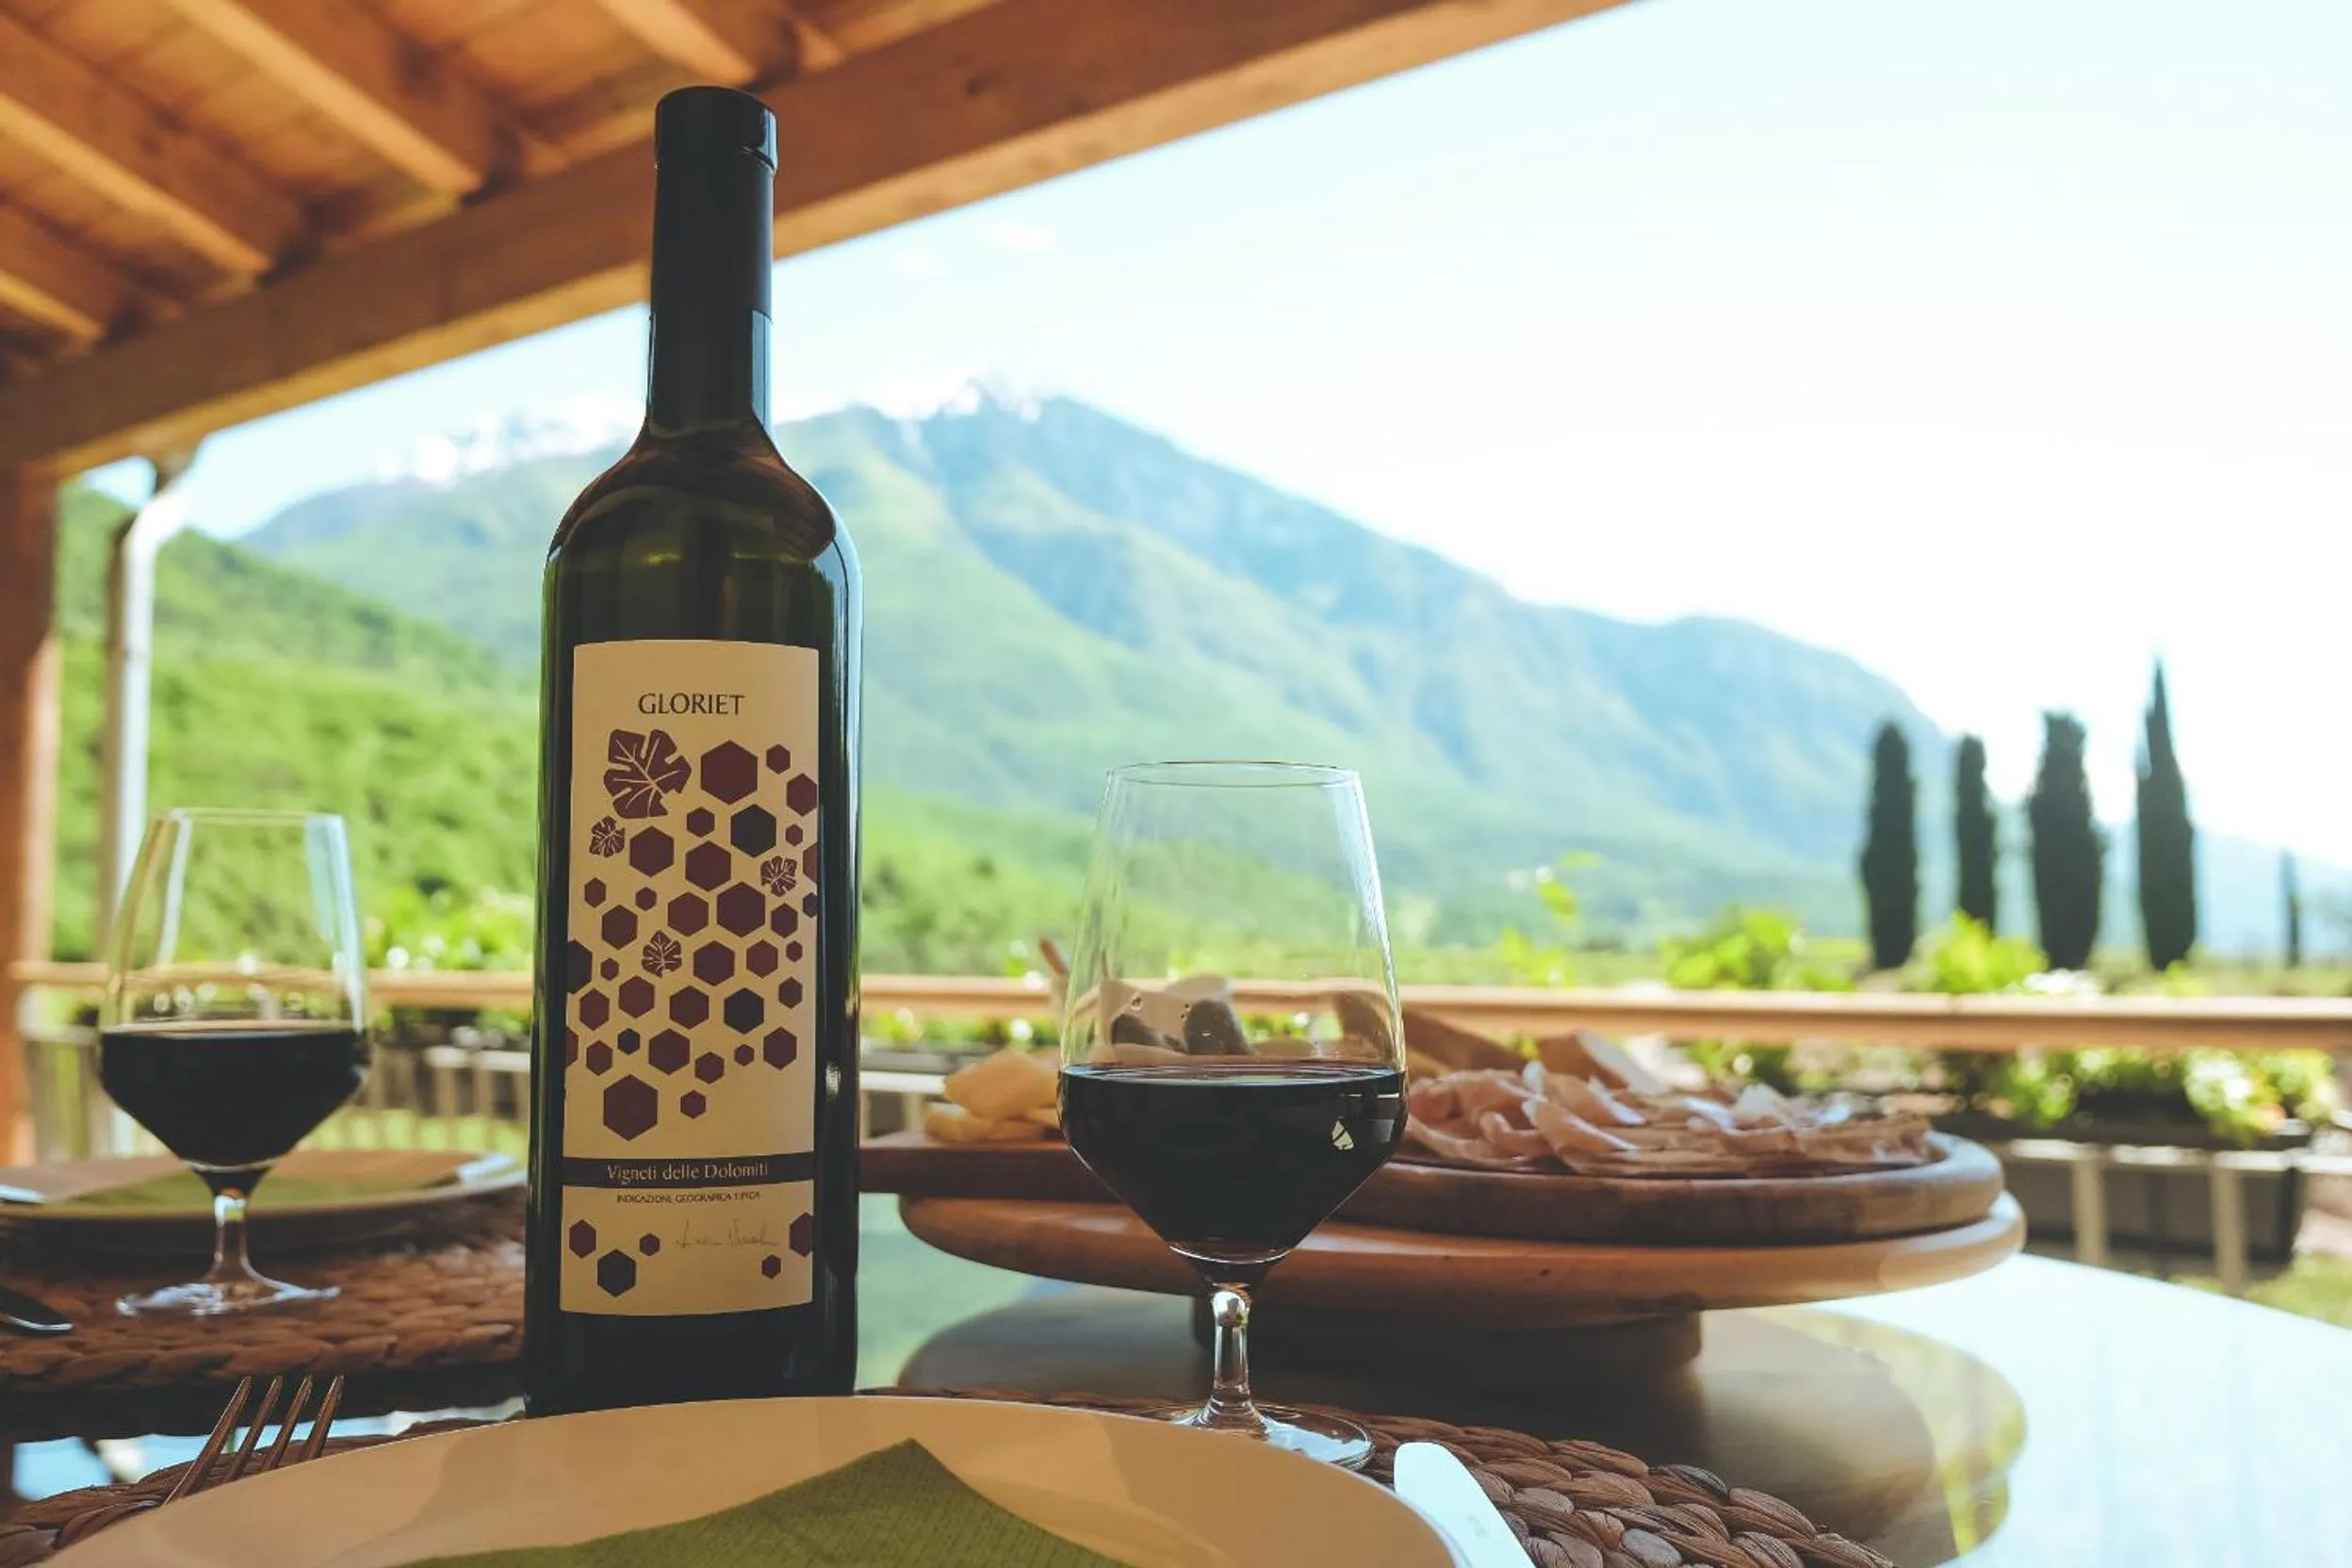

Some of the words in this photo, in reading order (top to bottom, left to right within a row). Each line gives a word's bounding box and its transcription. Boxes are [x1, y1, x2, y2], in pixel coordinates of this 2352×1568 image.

[637, 693, 746, 715] GLORIET
[607, 1164, 657, 1184] Vigneti
[662, 1163, 700, 1180] delle
[705, 1161, 768, 1179] Dolomiti
[617, 1194, 673, 1203] INDICAZIONE
